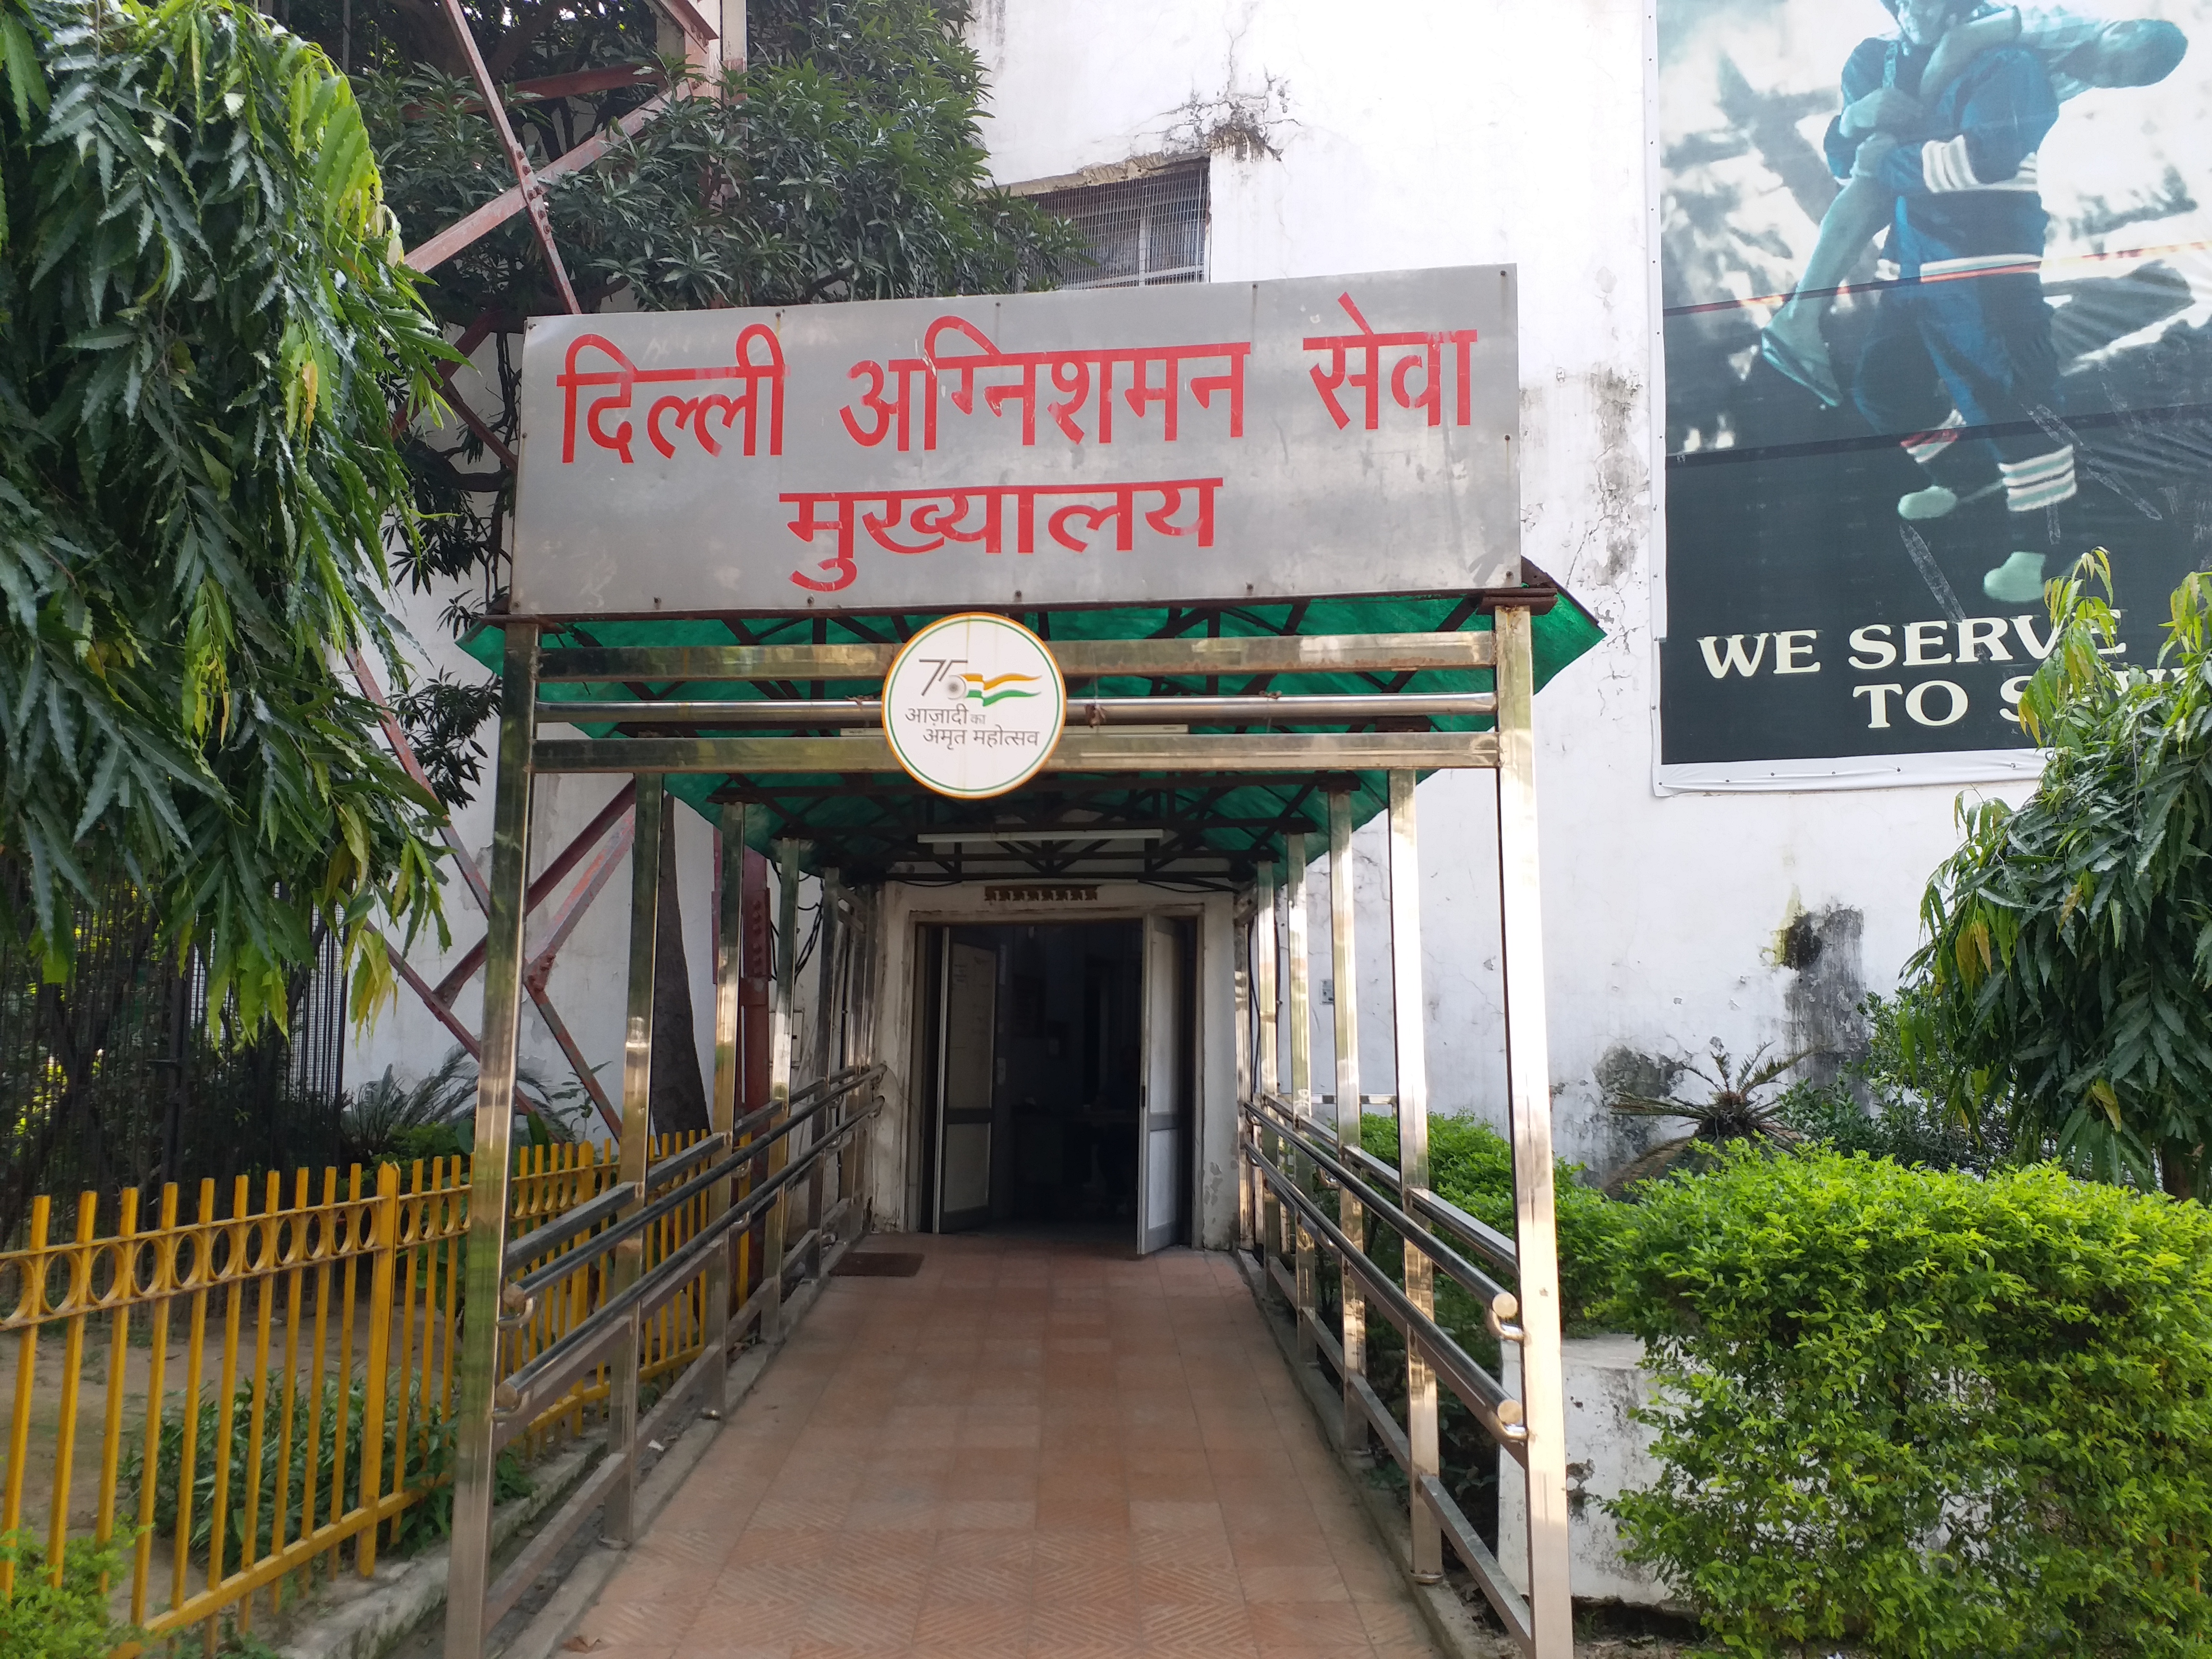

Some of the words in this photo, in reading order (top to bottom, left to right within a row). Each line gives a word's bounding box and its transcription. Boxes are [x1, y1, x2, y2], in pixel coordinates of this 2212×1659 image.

[557, 324, 790, 464] दिल्ली
[840, 315, 1250, 452] अग्निशमन
[1303, 292, 1477, 430] सेवा
[779, 478, 1223, 592] मुख्यालय
[1697, 630, 1821, 679] WE
[905, 703, 969, 725] आज़ादी
[971, 714, 986, 725] का
[1852, 680, 1969, 728] TO
[923, 728, 967, 750] अमृत
[973, 724, 1040, 748] महोत्सव
